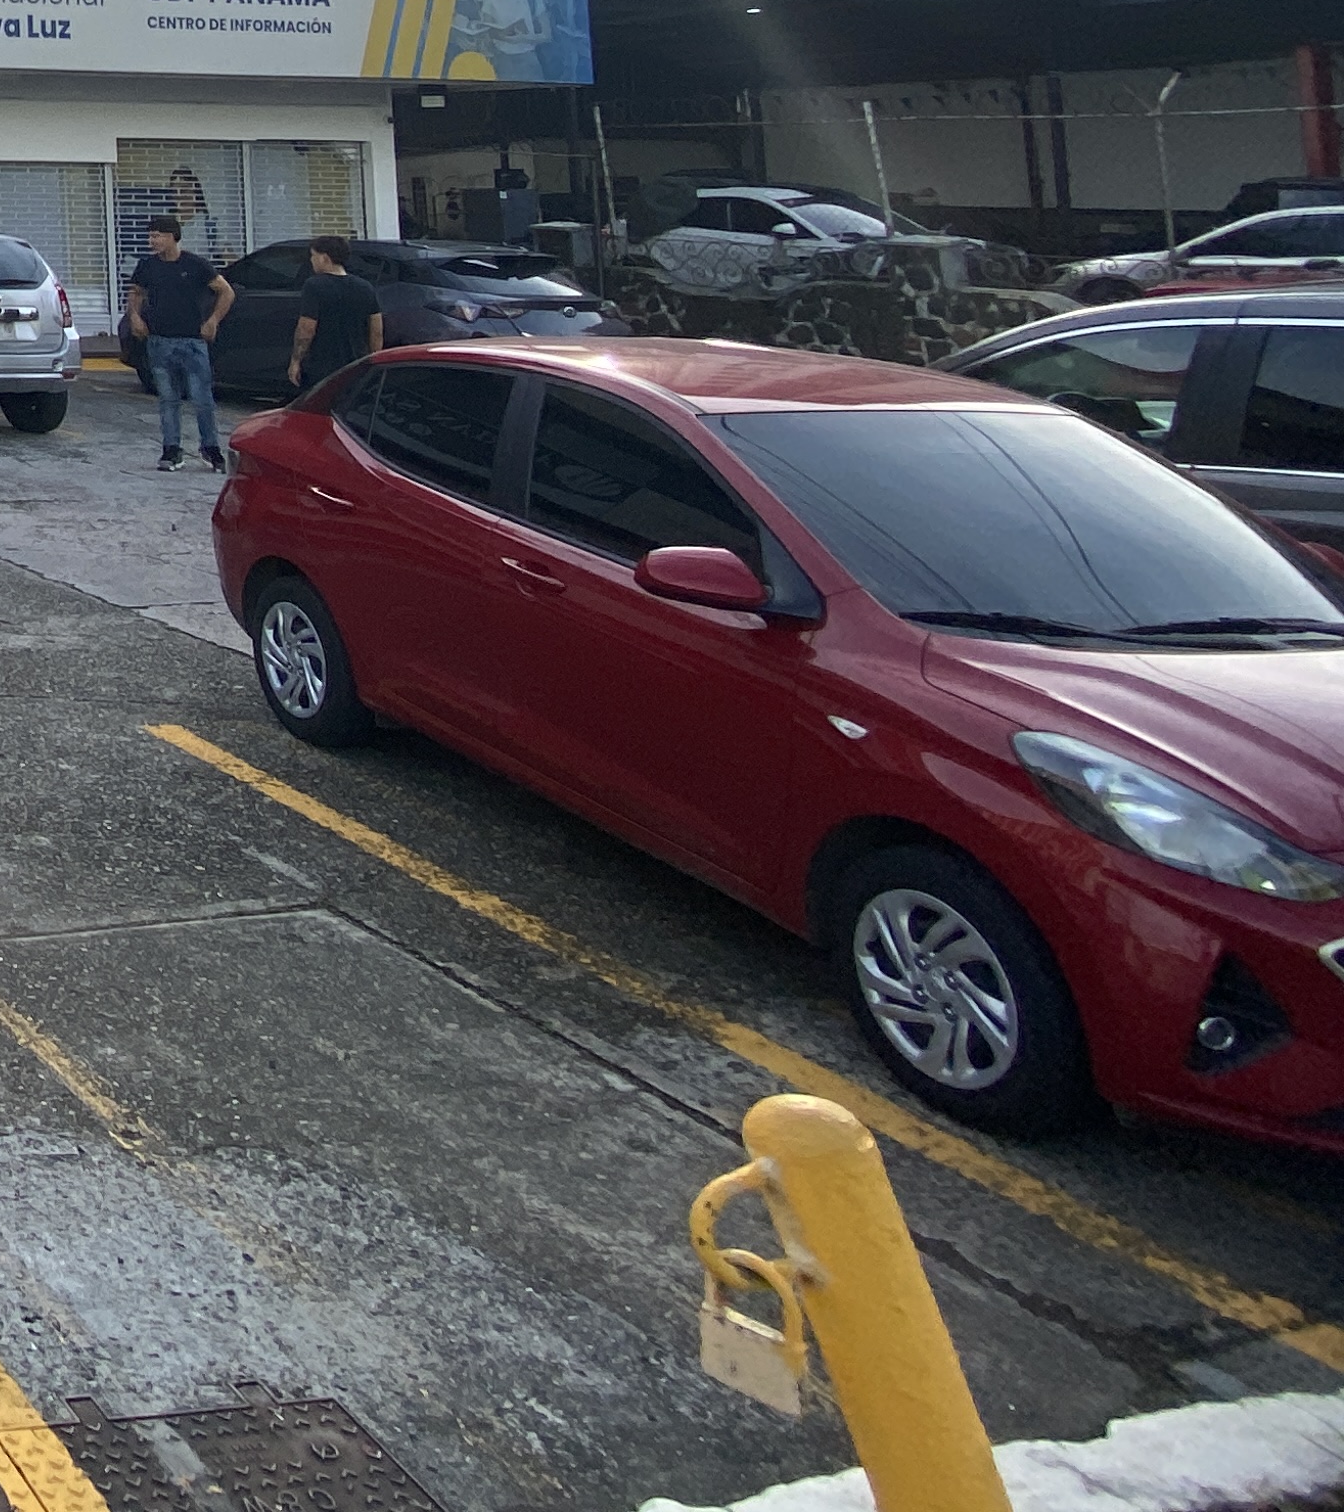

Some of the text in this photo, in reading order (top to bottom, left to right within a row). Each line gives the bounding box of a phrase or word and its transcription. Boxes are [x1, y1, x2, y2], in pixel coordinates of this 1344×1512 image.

[27, 14, 72, 39] Luz
[147, 15, 332, 34] CENTRO DE INFORMACIÓN
